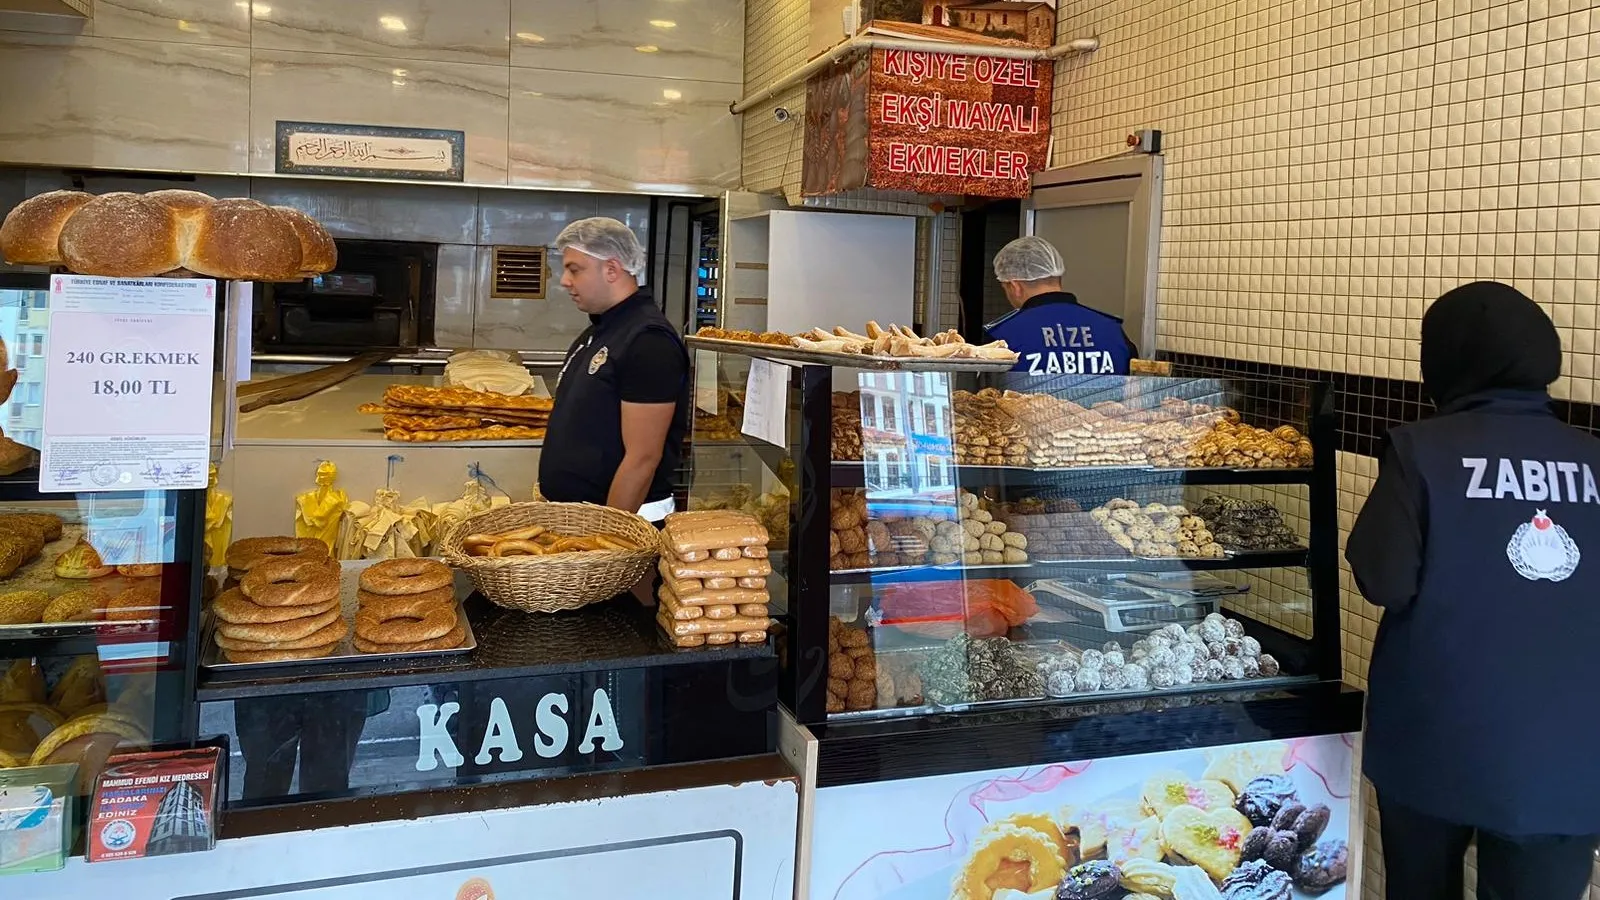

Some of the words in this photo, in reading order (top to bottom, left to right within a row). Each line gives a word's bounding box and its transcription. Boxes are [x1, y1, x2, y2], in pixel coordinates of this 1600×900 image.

[881, 91, 940, 133] EKŞİ
[947, 100, 1039, 134] MAYALI
[889, 143, 1029, 180] EKMEKLER
[1041, 323, 1094, 348] RİZE
[66, 351, 94, 364] 240
[100, 352, 200, 365] GR.EKMEK
[1026, 350, 1115, 376] ZABITA
[92, 380, 142, 397] 18,00
[148, 380, 177, 395] TL
[1462, 457, 1600, 505] ZABITA
[415, 687, 624, 772] KASA
[102, 778, 133, 787] MAHMUD
[134, 775, 158, 785] EFENDİ
[159, 775, 171, 783] KIZ
[172, 771, 209, 781] MEDRESESİ
[101, 796, 148, 804] SADAKA
[97, 809, 138, 820] EDİNİZ
